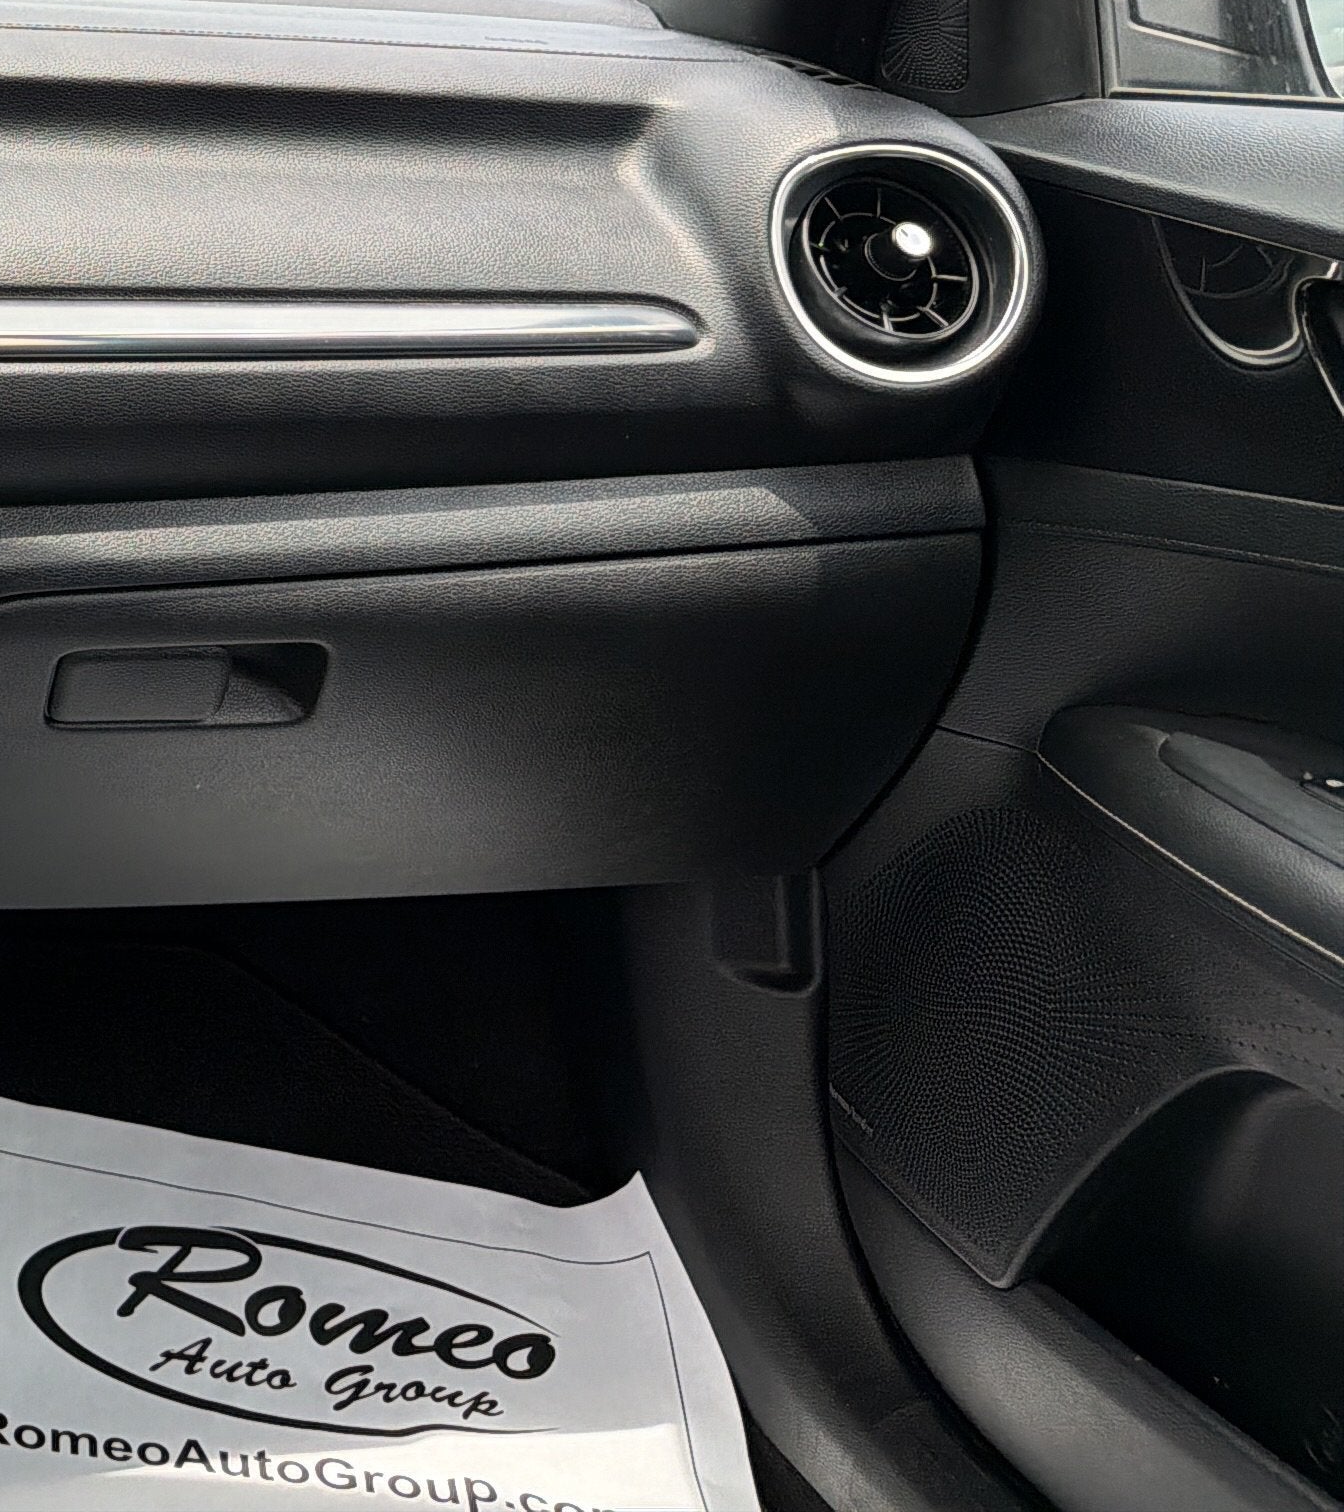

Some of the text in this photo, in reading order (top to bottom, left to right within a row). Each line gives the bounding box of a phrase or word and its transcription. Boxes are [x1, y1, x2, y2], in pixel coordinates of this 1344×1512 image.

[113, 1225, 558, 1381] Romeo
[148, 1335, 507, 1422] Auto Group
